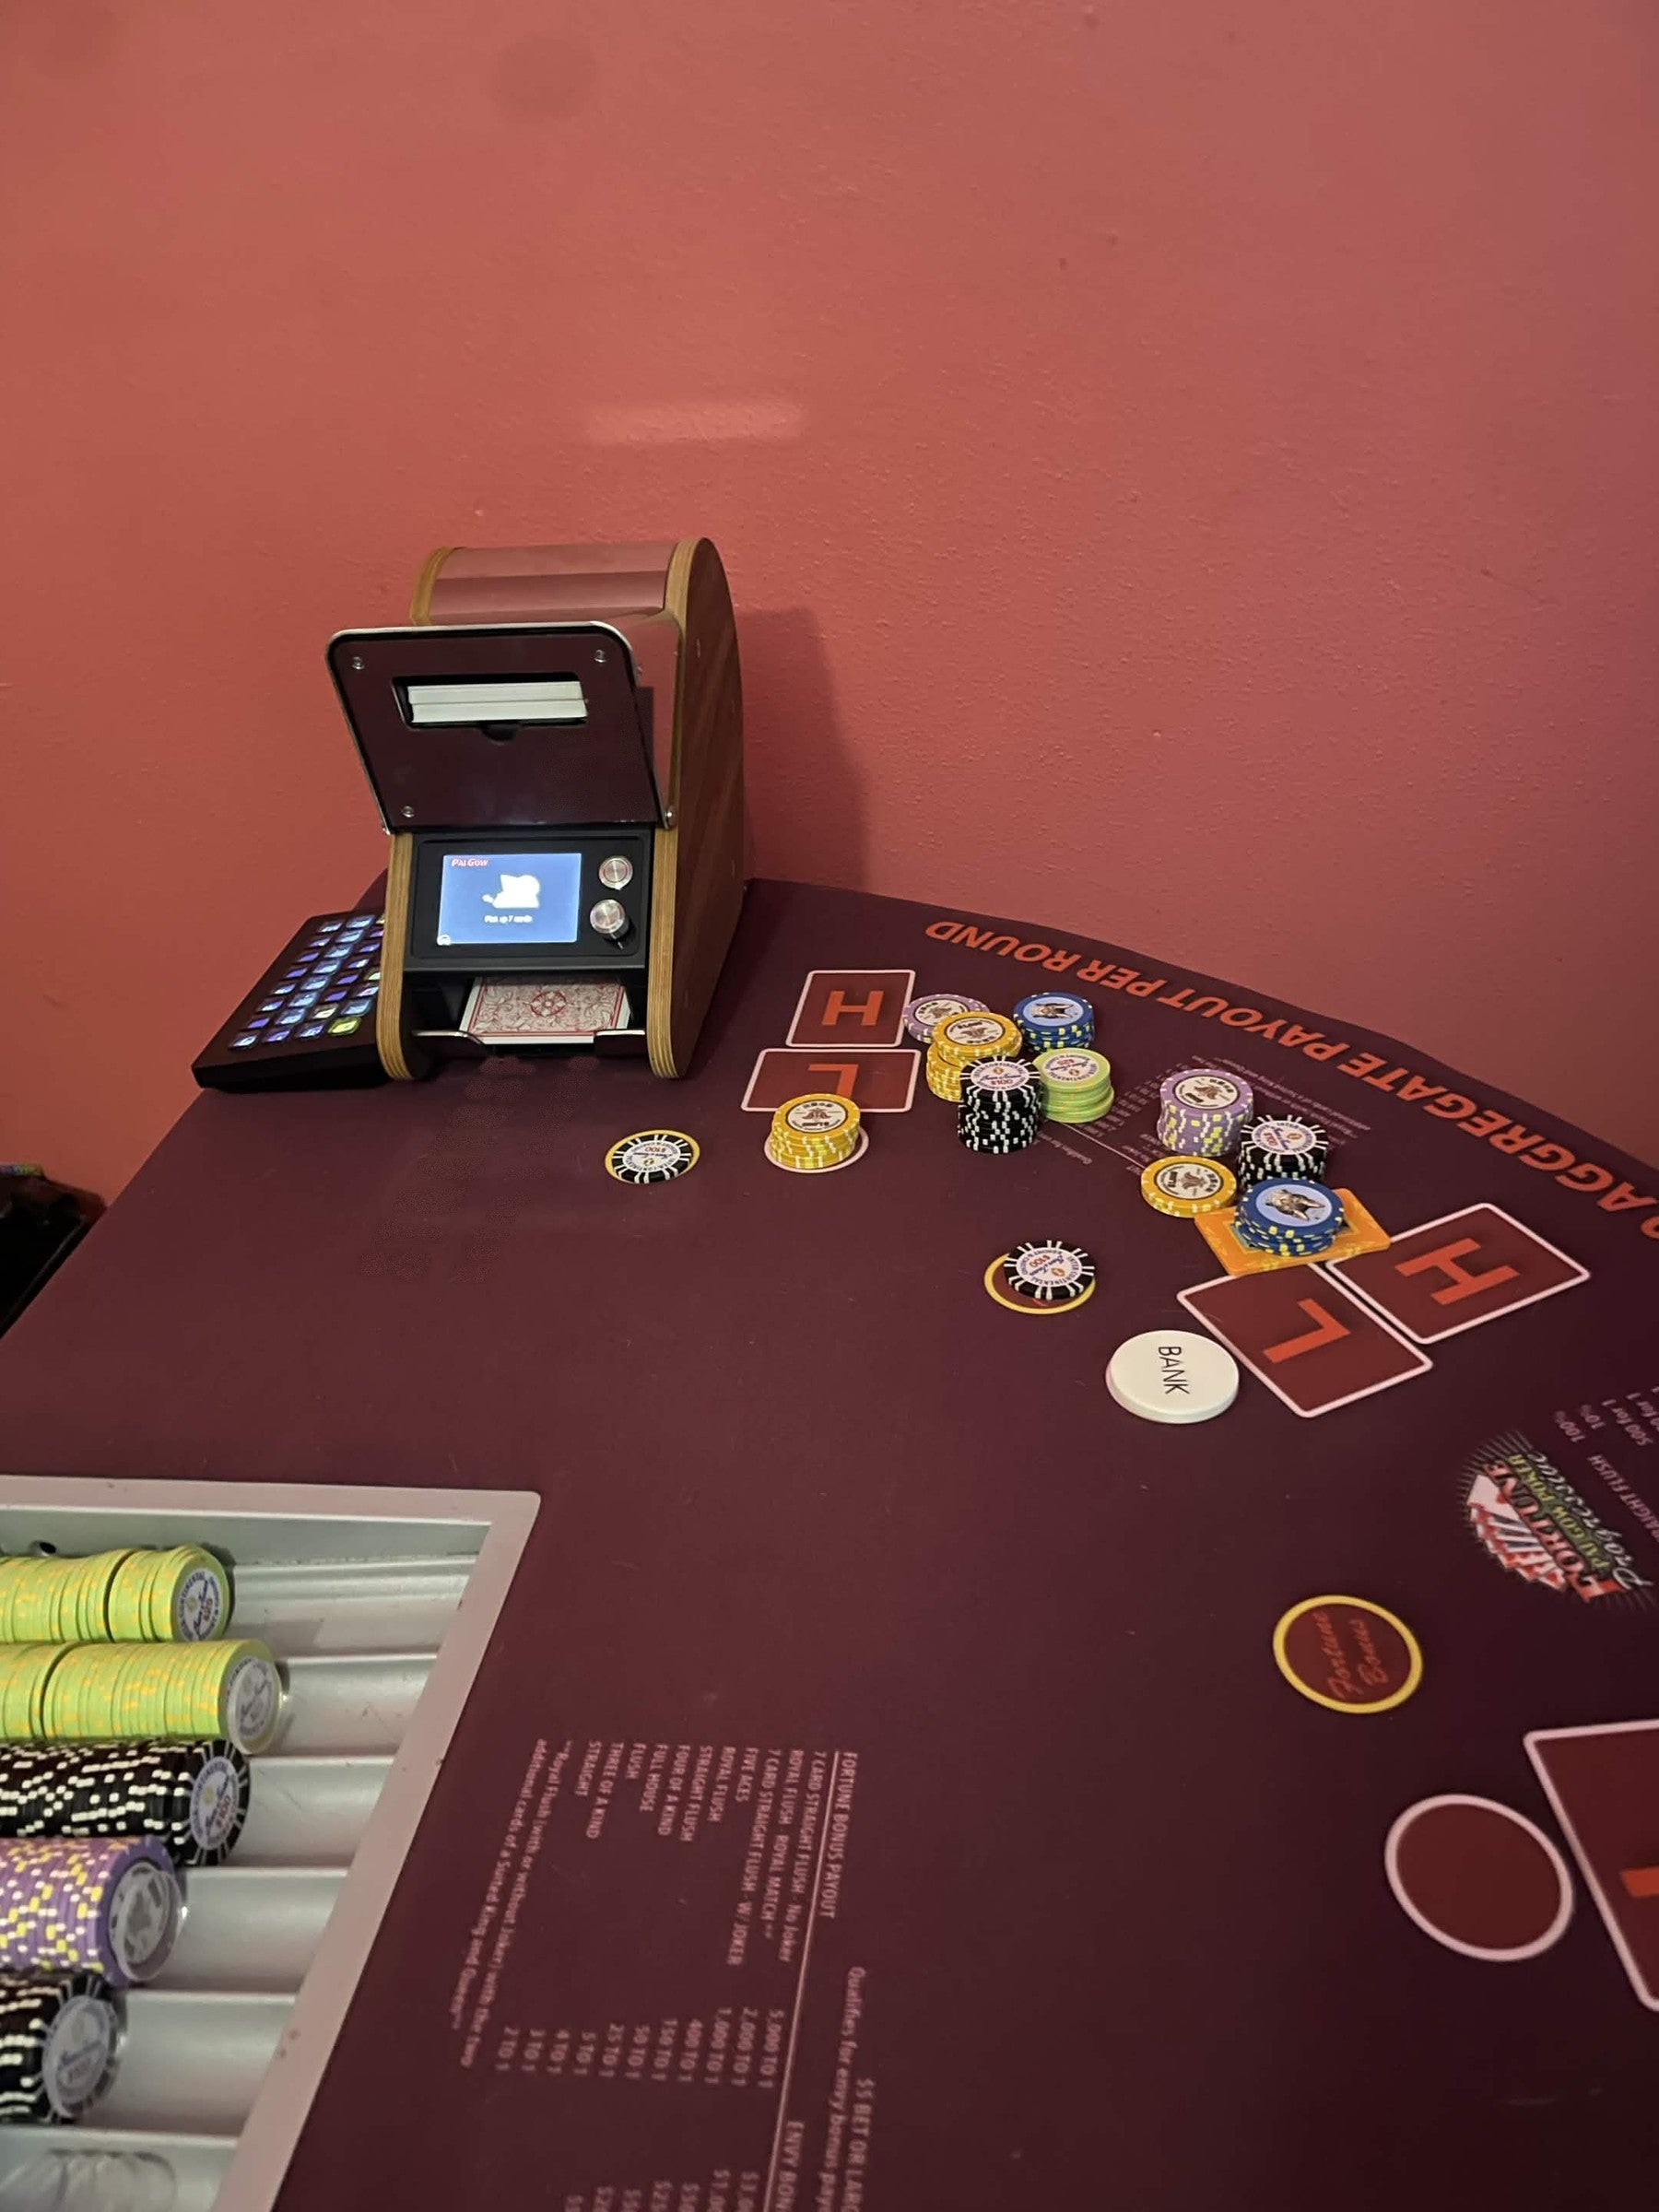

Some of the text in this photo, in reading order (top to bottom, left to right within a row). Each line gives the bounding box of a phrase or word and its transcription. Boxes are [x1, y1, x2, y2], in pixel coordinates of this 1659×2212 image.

[925, 921, 1082, 973] ROUND
[1077, 959, 1169, 998] PER
[822, 991, 884, 1026] H
[1159, 987, 1350, 1062] PAYOUT
[1337, 1052, 1658, 1211] AGGREGATE
[1394, 1237, 1520, 1306] H
[1264, 1298, 1351, 1363] L
[1158, 1345, 1189, 1395] BANK
[1612, 1407, 1632, 1425] for
[1624, 1424, 1654, 1447] 500
[1586, 1453, 1630, 1493] FLUSH
[1508, 1453, 1610, 1568] PAI GOW POKER
[1527, 1451, 1654, 1590] Progressive
[1483, 1460, 1624, 1603] FORTUNE
[1312, 1612, 1364, 1700] Fortune
[1348, 1618, 1389, 1686] Bonus
[575, 1741, 602, 1795] STRAIGHT
[603, 1743, 624, 1776] THREE
[626, 1743, 646, 1779] FLUSH
[639, 1745, 668, 1812] FULL HOUSE
[672, 1746, 690, 1775] FOUR
[735, 1748, 759, 1802] FIVE ACES
[761, 1758, 780, 1788] CARD
[785, 1750, 804, 1784] ROYAL
[807, 1760, 825, 1791] CARD
[599, 1780, 613, 1794] OF
[669, 1778, 683, 1791] OF
[680, 1746, 713, 1841] STRAIGHT FLUSH
[707, 1747, 735, 1822] ROYAL FLUSH
[586, 1808, 606, 1839] KIND
[657, 1806, 676, 1835] KIND
[750, 1792, 773, 1848] STRAIGHT
[779, 1787, 797, 1825] FLUSH
[797, 1794, 819, 1851] STRAIGHT
[770, 1834, 789, 1872] ROYAL
[819, 1752, 858, 1919] FORTUNE BONUS PAYOUT
[742, 1852, 761, 1892] FLUSH
[791, 1854, 809, 1894] FLUSH
[760, 1877, 781, 1921] MATCH
[785, 1904, 801, 1922] No
[725, 1923, 750, 1965] JOKER
[778, 1925, 799, 1962] Joker
[841, 1966, 866, 2036] Qualifies
[498, 2041, 516, 2058] TO
[524, 2042, 543, 2060] TO
[550, 2043, 568, 2062] TO
[576, 2044, 594, 2063] TO
[603, 2047, 620, 2065] TO
[628, 2049, 646, 2066] TO
[653, 2050, 671, 2068] TO
[679, 2053, 699, 2070] TO
[706, 2053, 724, 2072] TO
[733, 2055, 750, 2073] TO
[759, 2056, 778, 2076] TO
[838, 2041, 858, 2064] for
[828, 2068, 848, 2110] envy
[852, 2103, 871, 2136] BET
[782, 2121, 806, 2167] ENVY
[825, 2114, 846, 2169] bonus
[847, 2140, 867, 2164] OR
